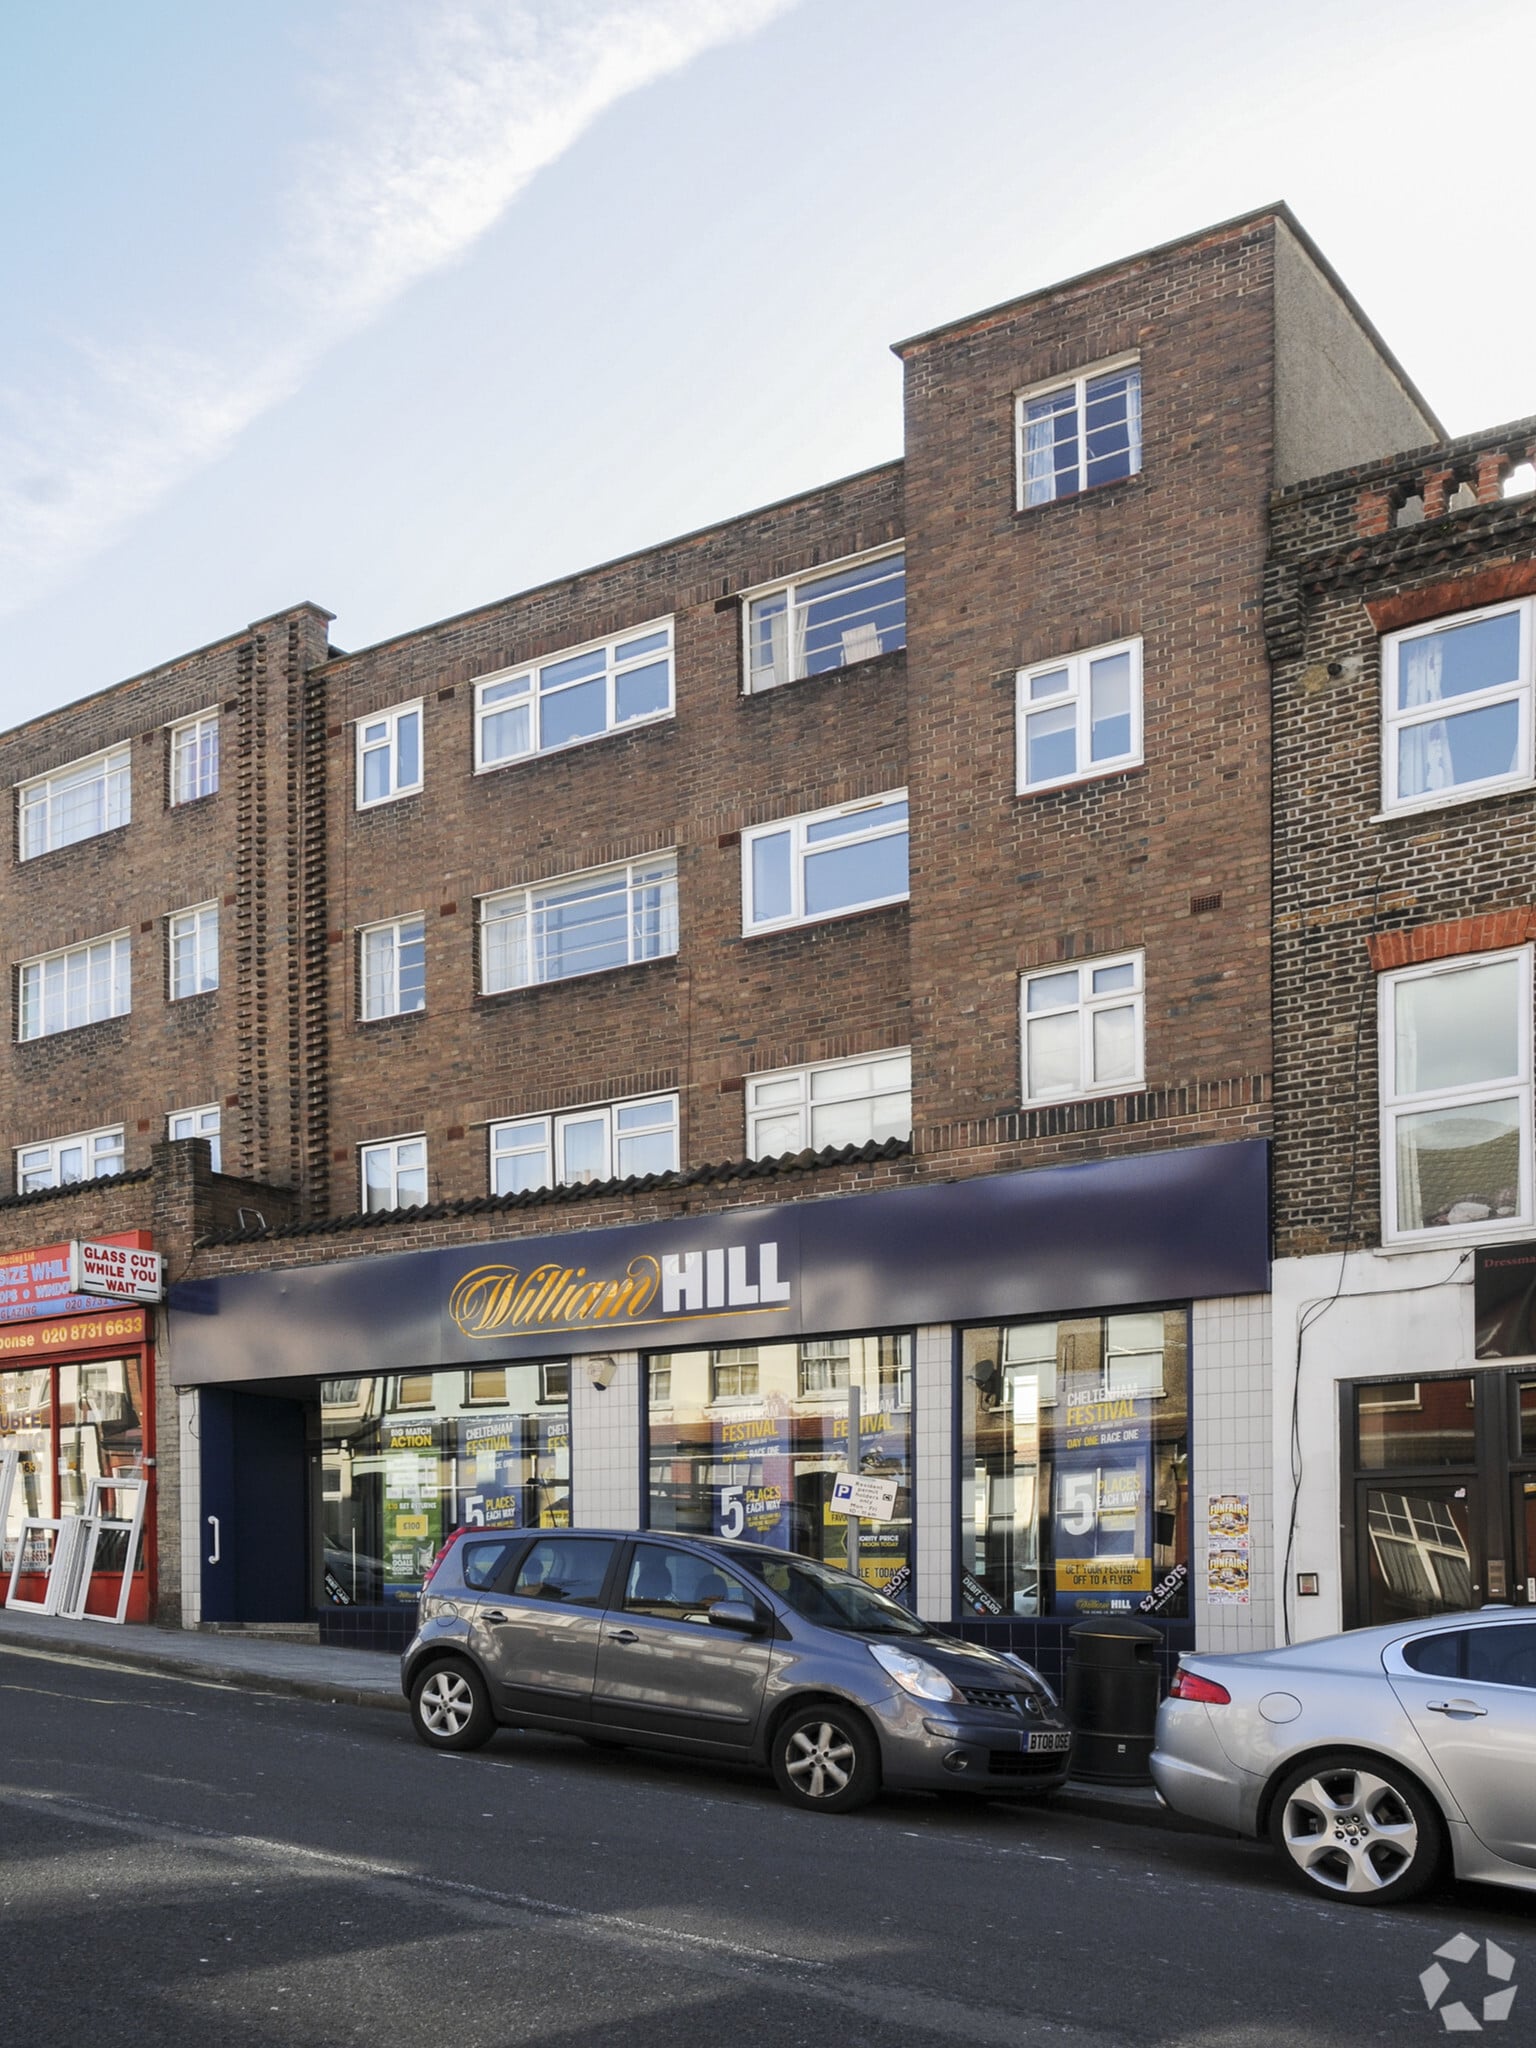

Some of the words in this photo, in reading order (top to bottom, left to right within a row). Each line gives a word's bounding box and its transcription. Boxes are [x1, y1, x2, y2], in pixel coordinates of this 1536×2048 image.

[84, 1247, 126, 1264] GLASS
[131, 1255, 156, 1268] CUT
[84, 1261, 125, 1278] WHILE
[130, 1268, 156, 1283] YOU
[105, 1279, 137, 1294] WAIT
[450, 1254, 661, 1335] William
[662, 1242, 791, 1313] HILL
[0, 1306, 36, 1319] GLAZING
[42, 1326, 67, 1344] 020
[71, 1322, 103, 1340] 8731
[105, 1316, 143, 1336] 6633
[1066, 1398, 1138, 1427] FESTIVAL
[391, 1428, 404, 1437] BIG
[405, 1426, 432, 1436] MATCH
[465, 1422, 513, 1440] CHELTENHAM
[721, 1419, 779, 1443] FESTIVAL
[833, 1412, 894, 1439] FETIVAL
[391, 1435, 433, 1448] ACTION
[465, 1435, 513, 1456] FESTIVAL
[1066, 1437, 1082, 1449] DAY
[1084, 1435, 1099, 1447] ONE
[1100, 1432, 1121, 1445] RACE
[1123, 1429, 1139, 1441] ONE
[745, 1502, 764, 1514] EACH
[766, 1499, 782, 1511] WAY
[1064, 1474, 1092, 1535] 5
[1097, 1475, 1141, 1495] PLACES
[1097, 1494, 1119, 1508] EACH
[1121, 1490, 1141, 1504] WAY
[1209, 1503, 1248, 1515] FUNFAIRS
[465, 1495, 484, 1526] 5
[485, 1496, 516, 1510] PLACES
[485, 1510, 501, 1521] EACH
[502, 1508, 516, 1519] WAY
[720, 1485, 744, 1539] 5
[745, 1485, 782, 1503] PLACES
[1066, 1564, 1079, 1574] GET
[1082, 1564, 1102, 1574] YOUR
[1104, 1562, 1141, 1574] FESTIVAL
[1209, 1558, 1248, 1571] FUNFAIRS
[883, 1566, 911, 1596] SLOTS
[1073, 1576, 1088, 1585] OFF
[1090, 1576, 1100, 1585] TO
[1102, 1575, 1108, 1584] A
[1110, 1575, 1133, 1585] FLYER
[1140, 1595, 1157, 1612] £2
[1153, 1564, 1188, 1597] SLOTS
[962, 1577, 982, 1596] DEBIT
[980, 1594, 1000, 1615] CARD
[1111, 1599, 1132, 1609] HILL
